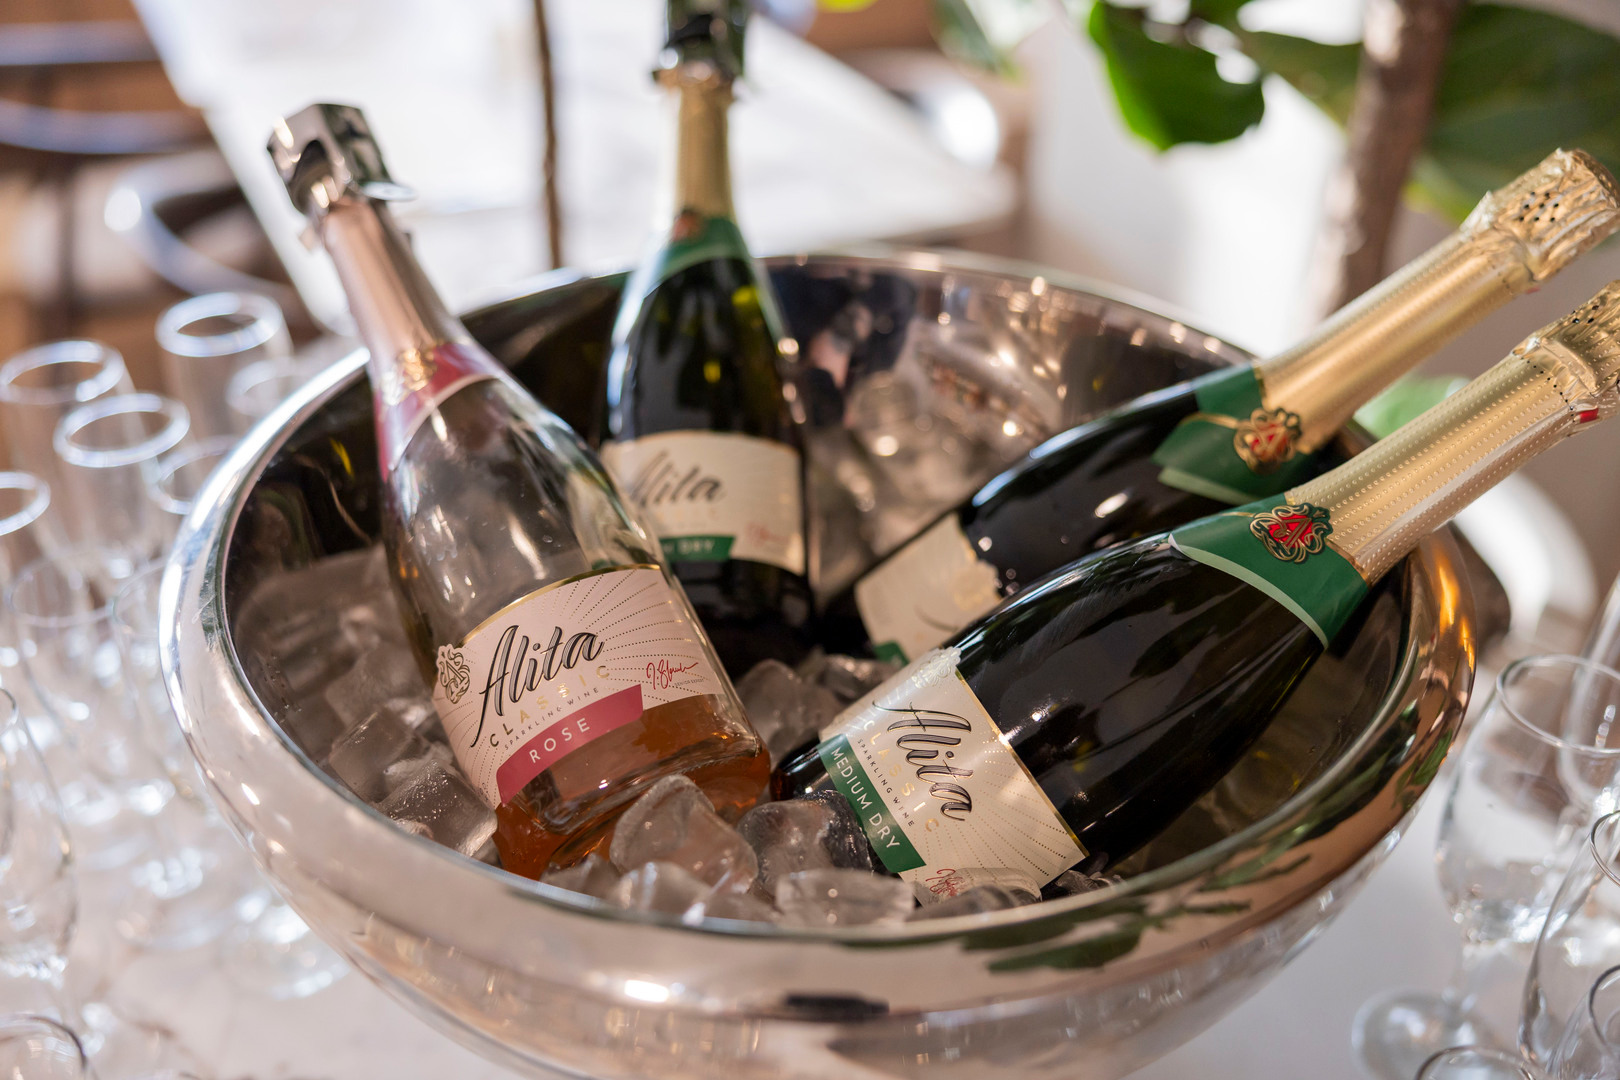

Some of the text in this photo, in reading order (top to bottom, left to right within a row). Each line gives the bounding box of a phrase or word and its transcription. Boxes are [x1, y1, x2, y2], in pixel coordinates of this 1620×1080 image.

[471, 625, 605, 747] Alita
[489, 665, 610, 747] CLASSIC
[504, 687, 598, 750] SPARKLING WINE
[529, 718, 590, 763] ROSE
[857, 739, 915, 827] SPARKLING WINE
[863, 720, 939, 832] CLASSIC
[872, 700, 973, 821] Alita
[831, 746, 900, 848] MEDIUM DRY
